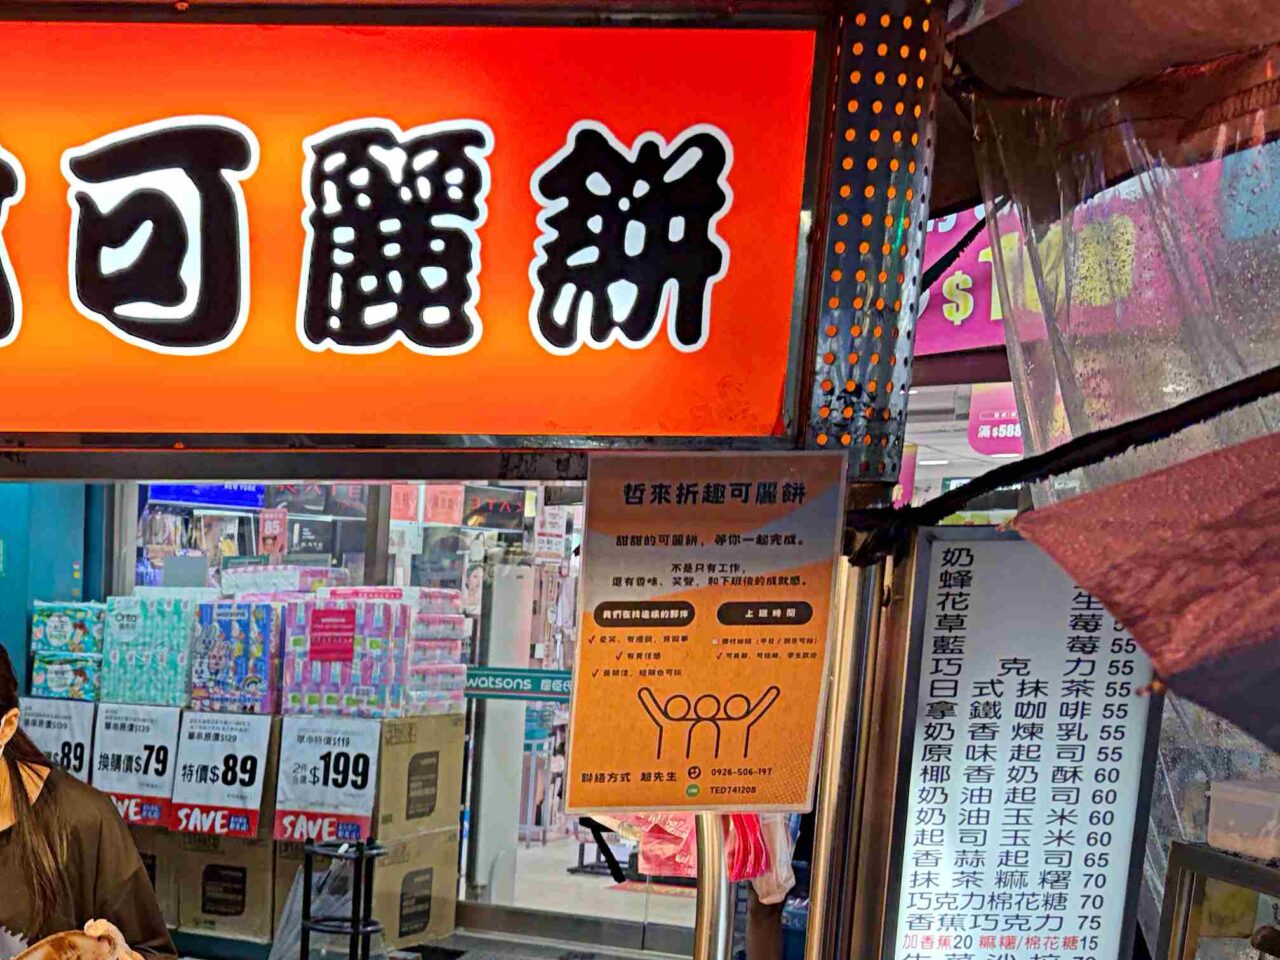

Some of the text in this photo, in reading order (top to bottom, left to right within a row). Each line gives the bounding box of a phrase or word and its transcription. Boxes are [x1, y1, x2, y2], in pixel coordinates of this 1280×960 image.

[623, 482, 806, 505] 哲來折趣可麗餅
[1110, 639, 1136, 653] 55
[930, 658, 1134, 676] 巧克力 55
[466, 677, 532, 690] watsons
[930, 680, 1131, 698] 日式抹茶 55
[925, 701, 1128, 720] 拿鐵咖啡 55
[924, 723, 1126, 741] 奶香煉乳 55
[921, 744, 1122, 762] 原味起司 55
[711, 768, 772, 776] 0926-506-197
[920, 766, 1120, 784] 椰香奶酥 60
[918, 787, 1117, 805] 奶油起司 60
[178, 808, 229, 834] SAVE
[915, 808, 1114, 826] 奶油玉米 60
[282, 815, 337, 840] SAVE
[914, 829, 1112, 846] 起司玉米 60
[912, 851, 1109, 867] 香蒜起司 65
[1082, 874, 1106, 888] 70
[907, 893, 1104, 911] 巧克力棉花糖 70
[905, 914, 1101, 932] 香蕉巧克力 75
